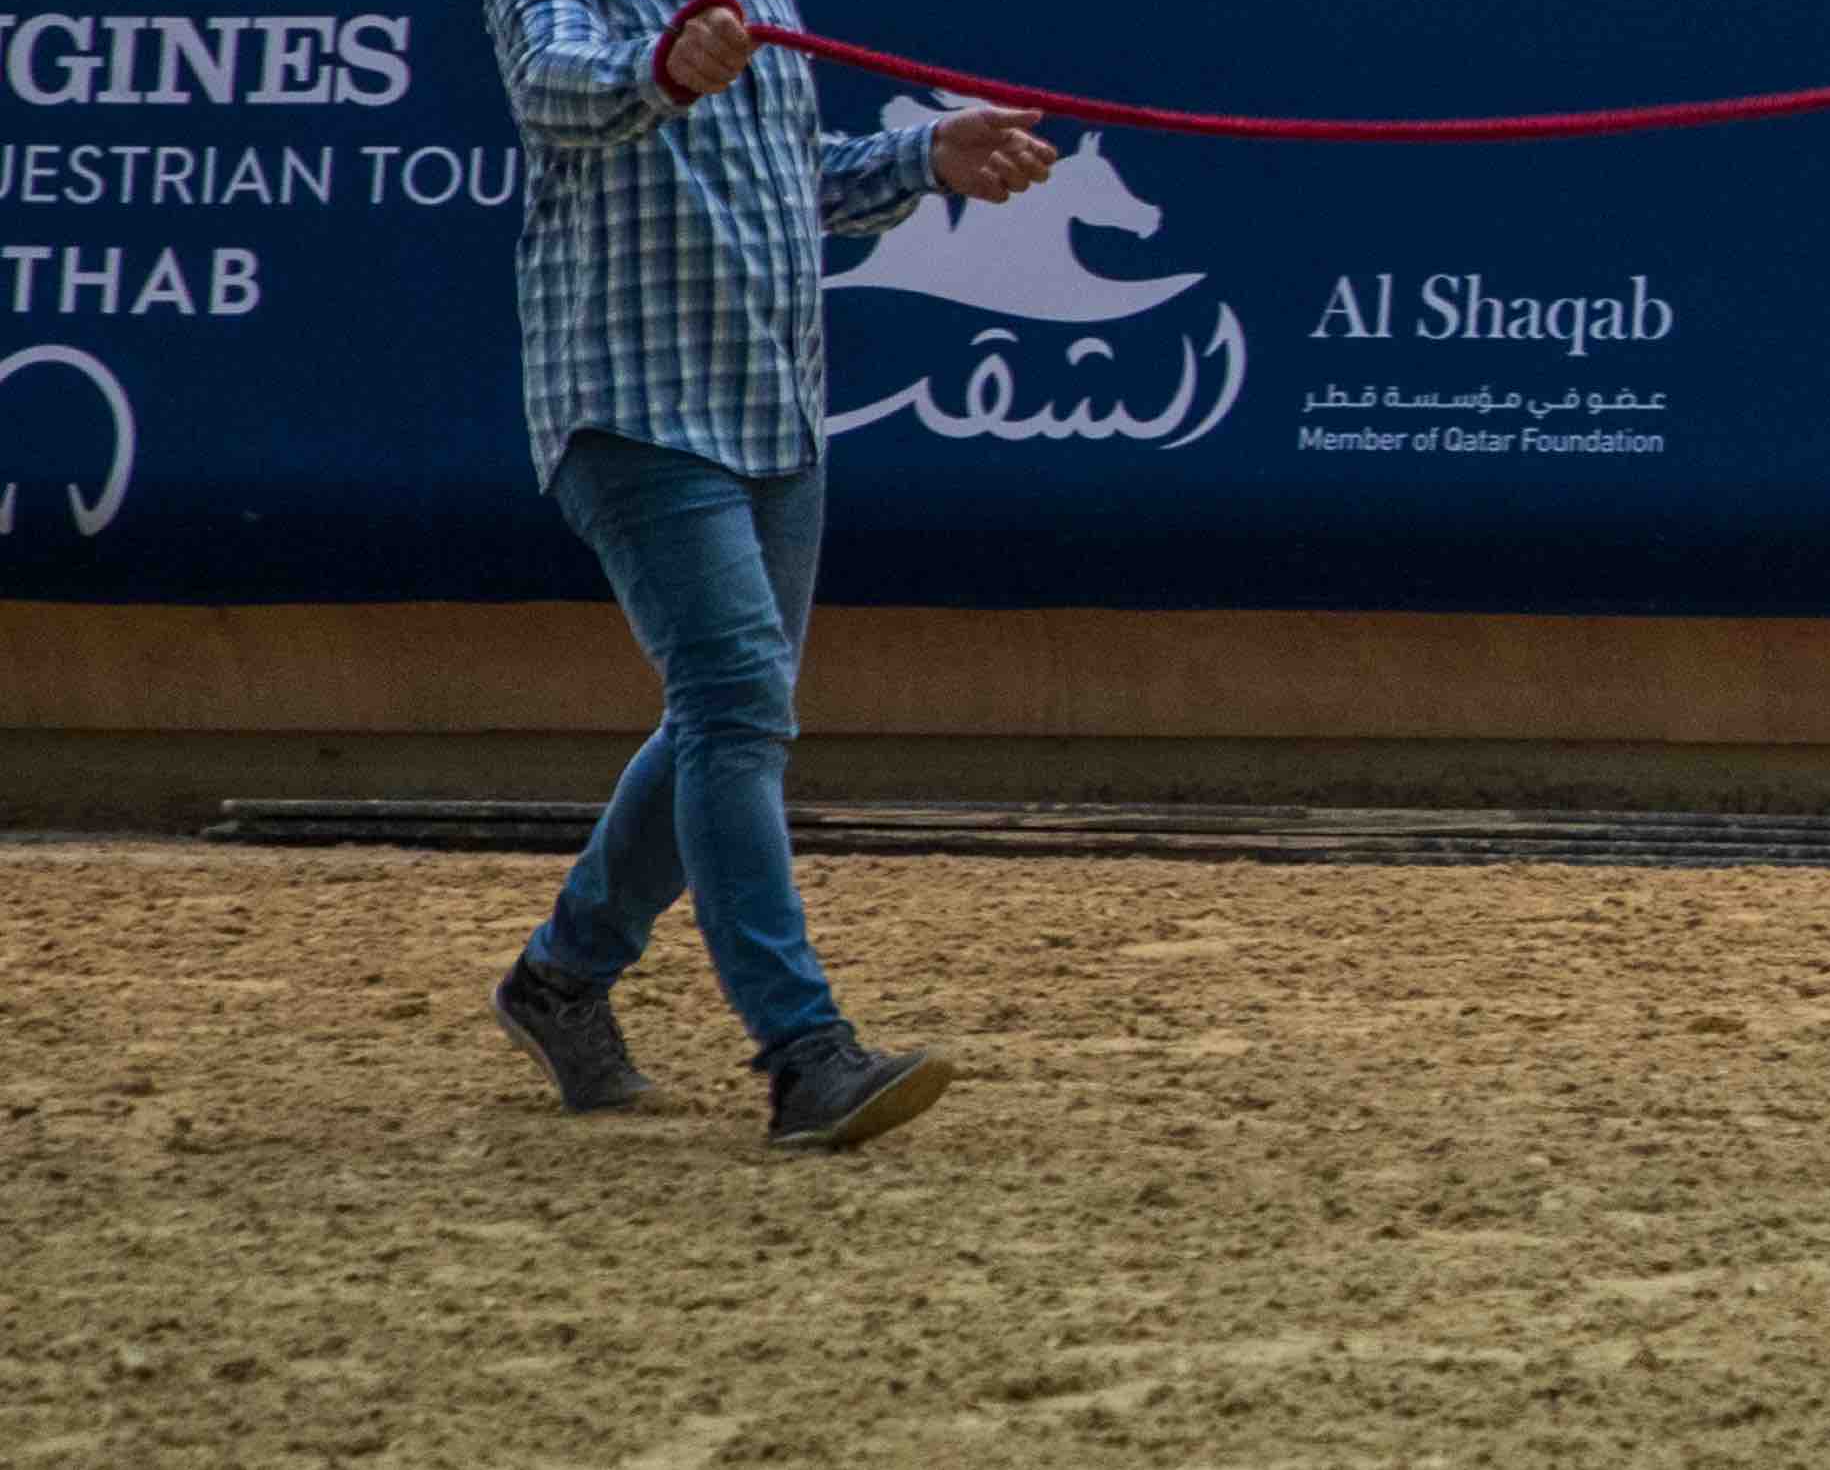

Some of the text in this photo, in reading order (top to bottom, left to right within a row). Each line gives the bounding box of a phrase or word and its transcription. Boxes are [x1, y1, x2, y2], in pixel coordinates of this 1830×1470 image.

[0, 13, 411, 107] GINES
[0, 245, 261, 315] THAB
[1308, 272, 1674, 357] Al Shaqab
[1301, 383, 1667, 420] عضو في مؤسسة قطر
[1297, 426, 1665, 453] Member of Qatar Foundation
